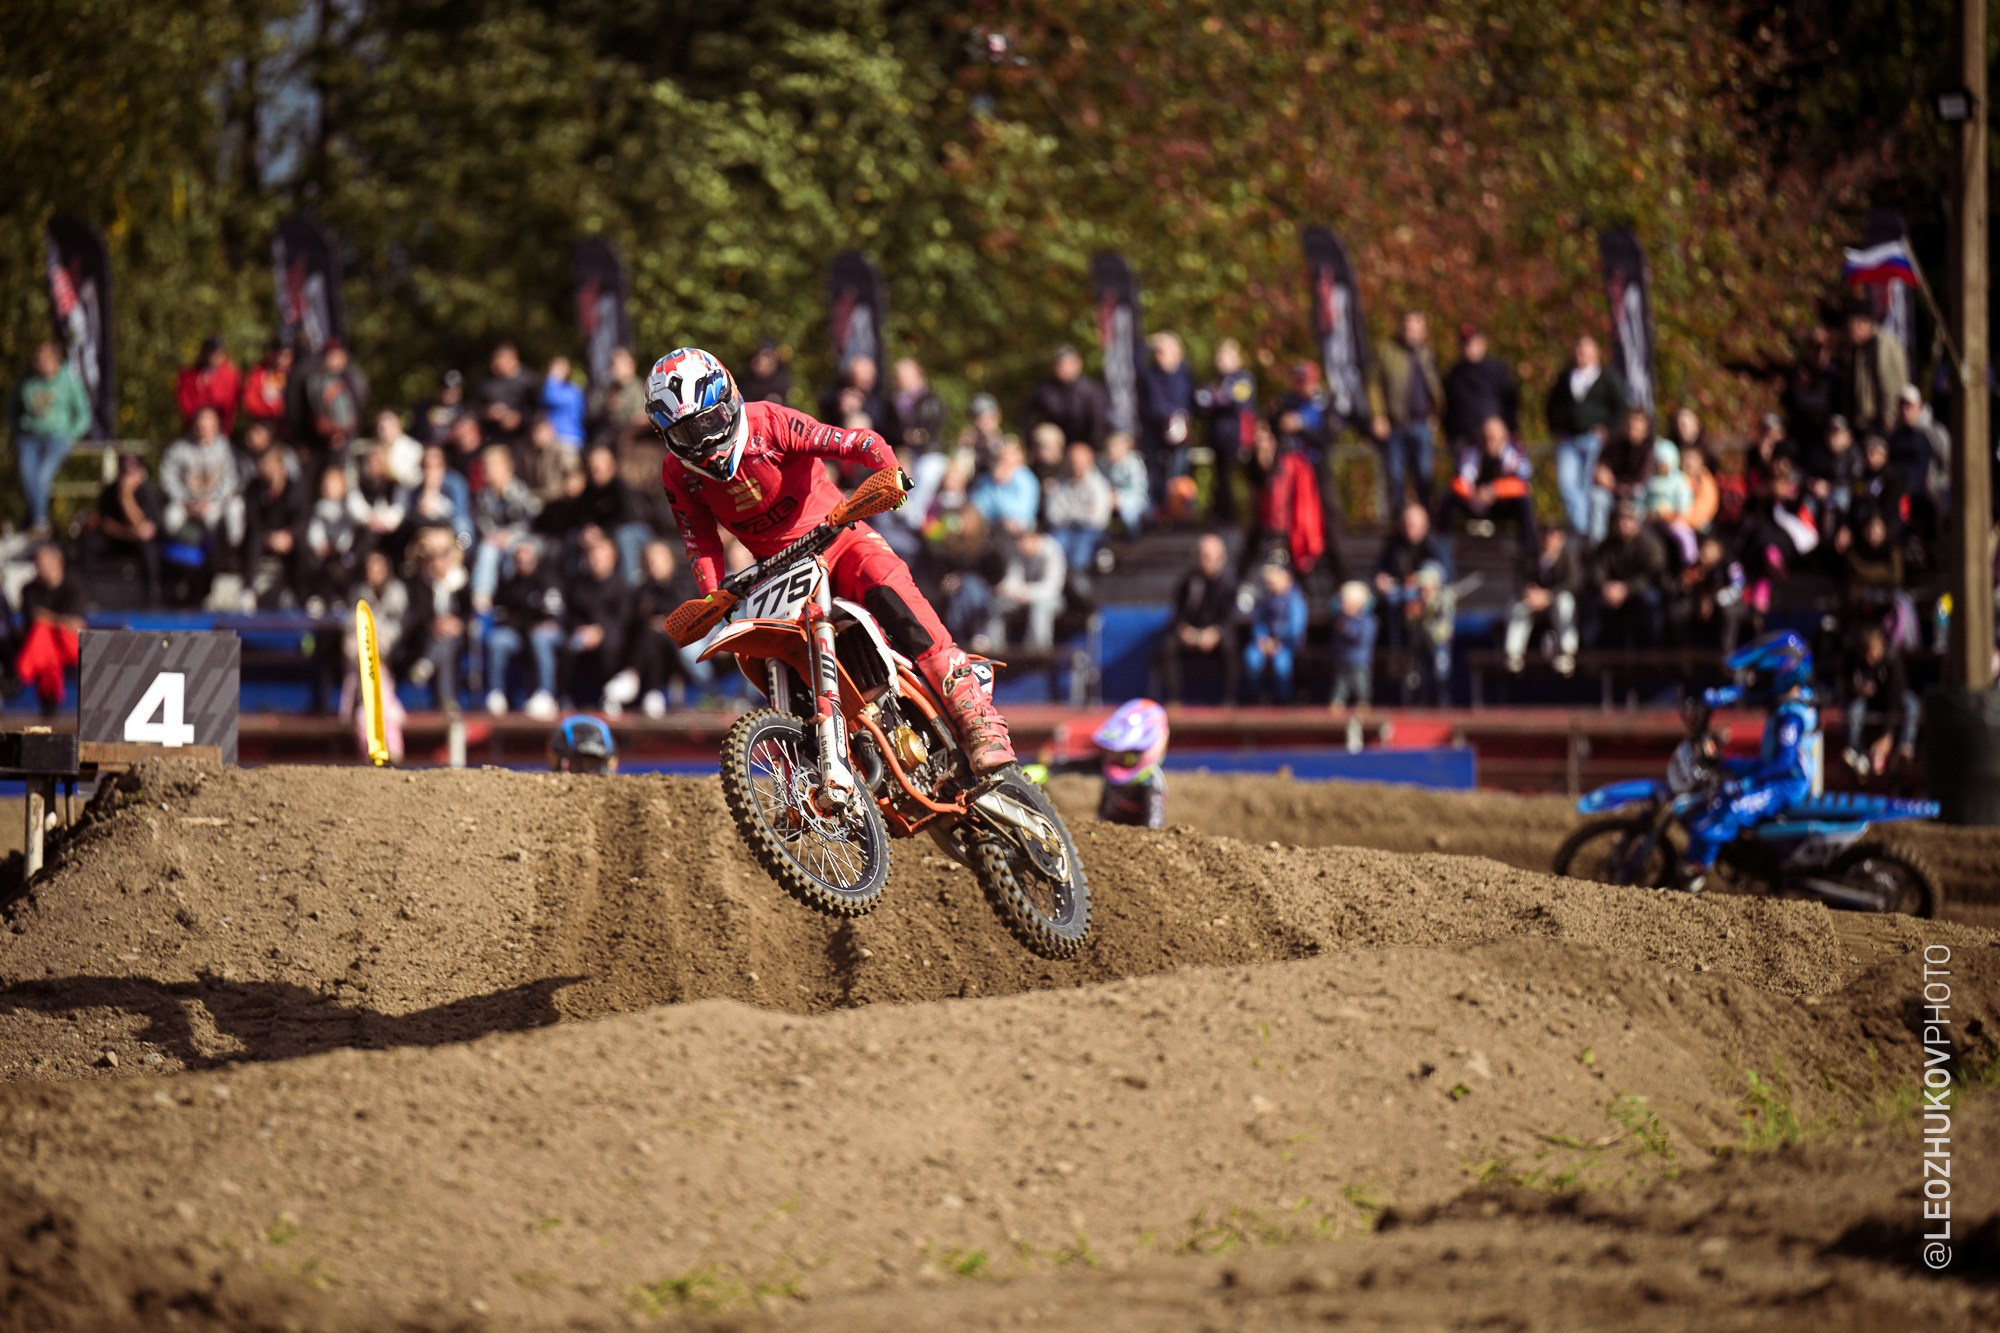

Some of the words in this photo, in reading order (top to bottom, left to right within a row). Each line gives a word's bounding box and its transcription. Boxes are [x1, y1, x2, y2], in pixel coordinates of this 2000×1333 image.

[762, 530, 818, 570] RENTHAL
[752, 567, 814, 619] 775
[124, 672, 195, 748] 4
